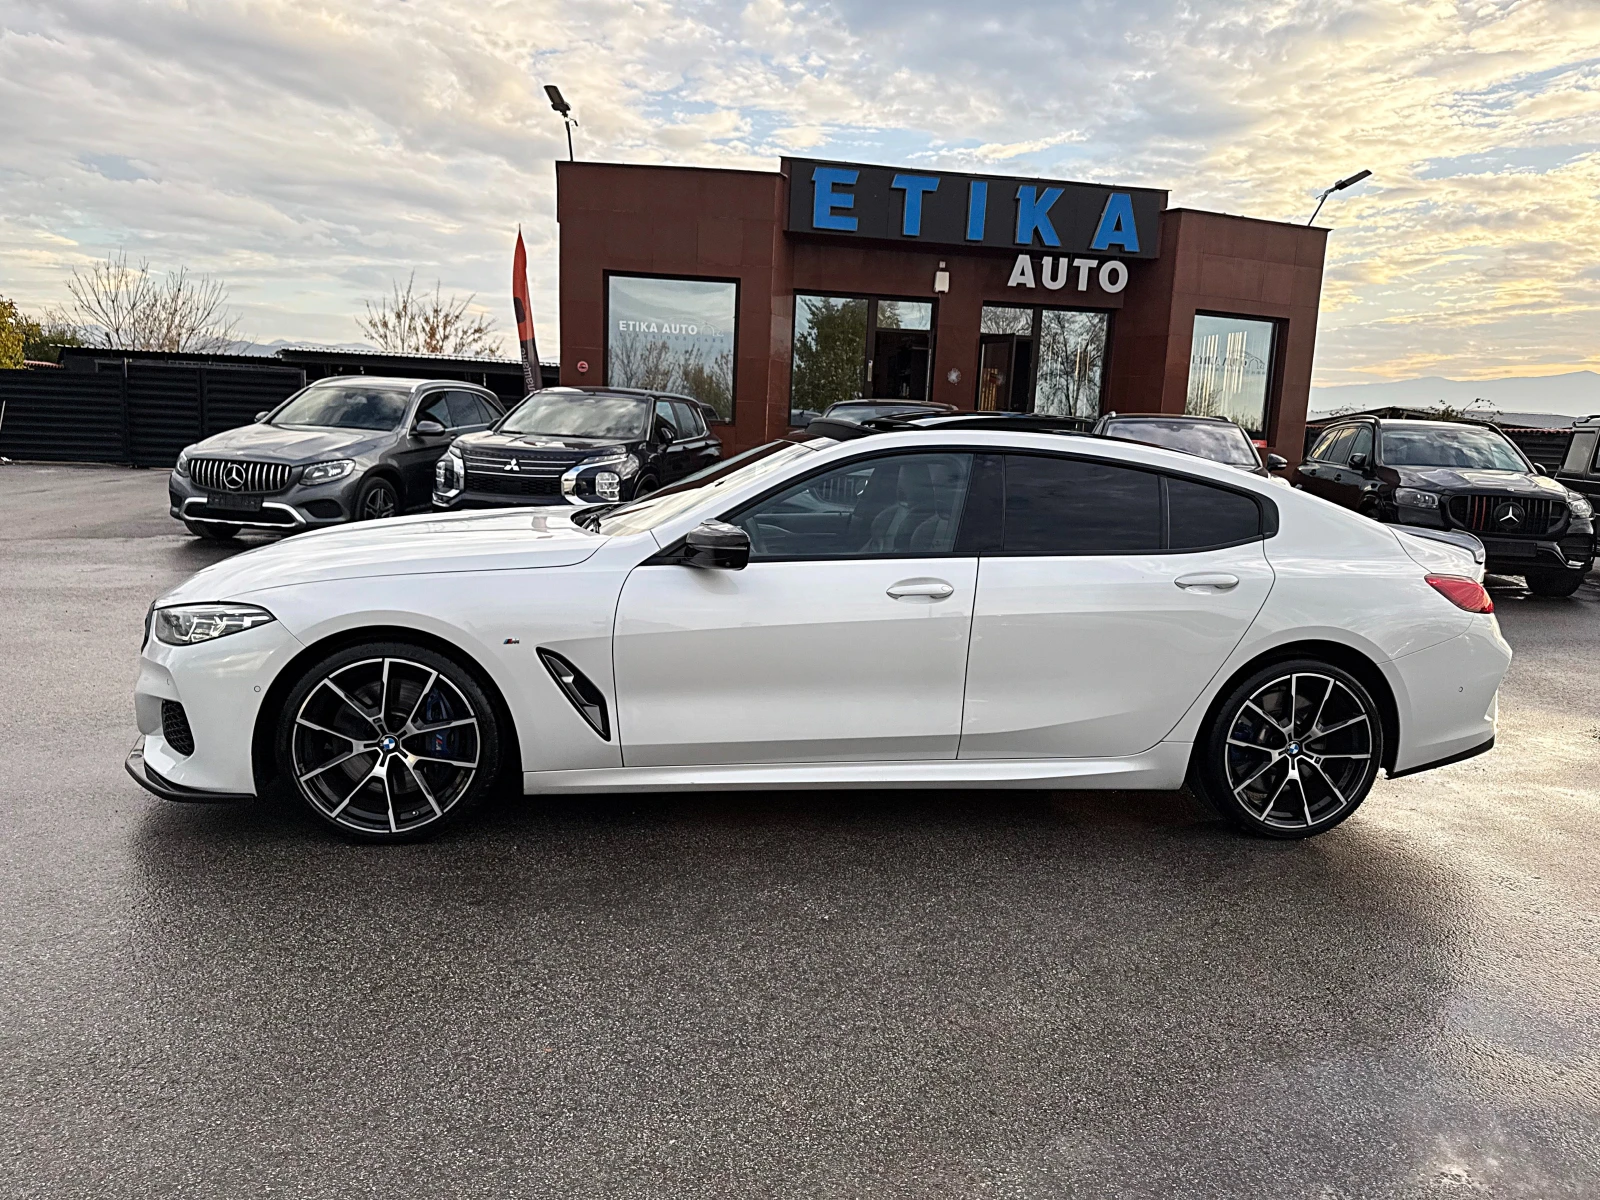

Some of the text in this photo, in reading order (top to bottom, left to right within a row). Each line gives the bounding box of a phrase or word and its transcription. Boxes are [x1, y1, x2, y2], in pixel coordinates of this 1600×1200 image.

[811, 166, 1140, 252] ETIKA
[1007, 254, 1129, 294] AUTO
[618, 320, 698, 335] ETIKA AUTO
